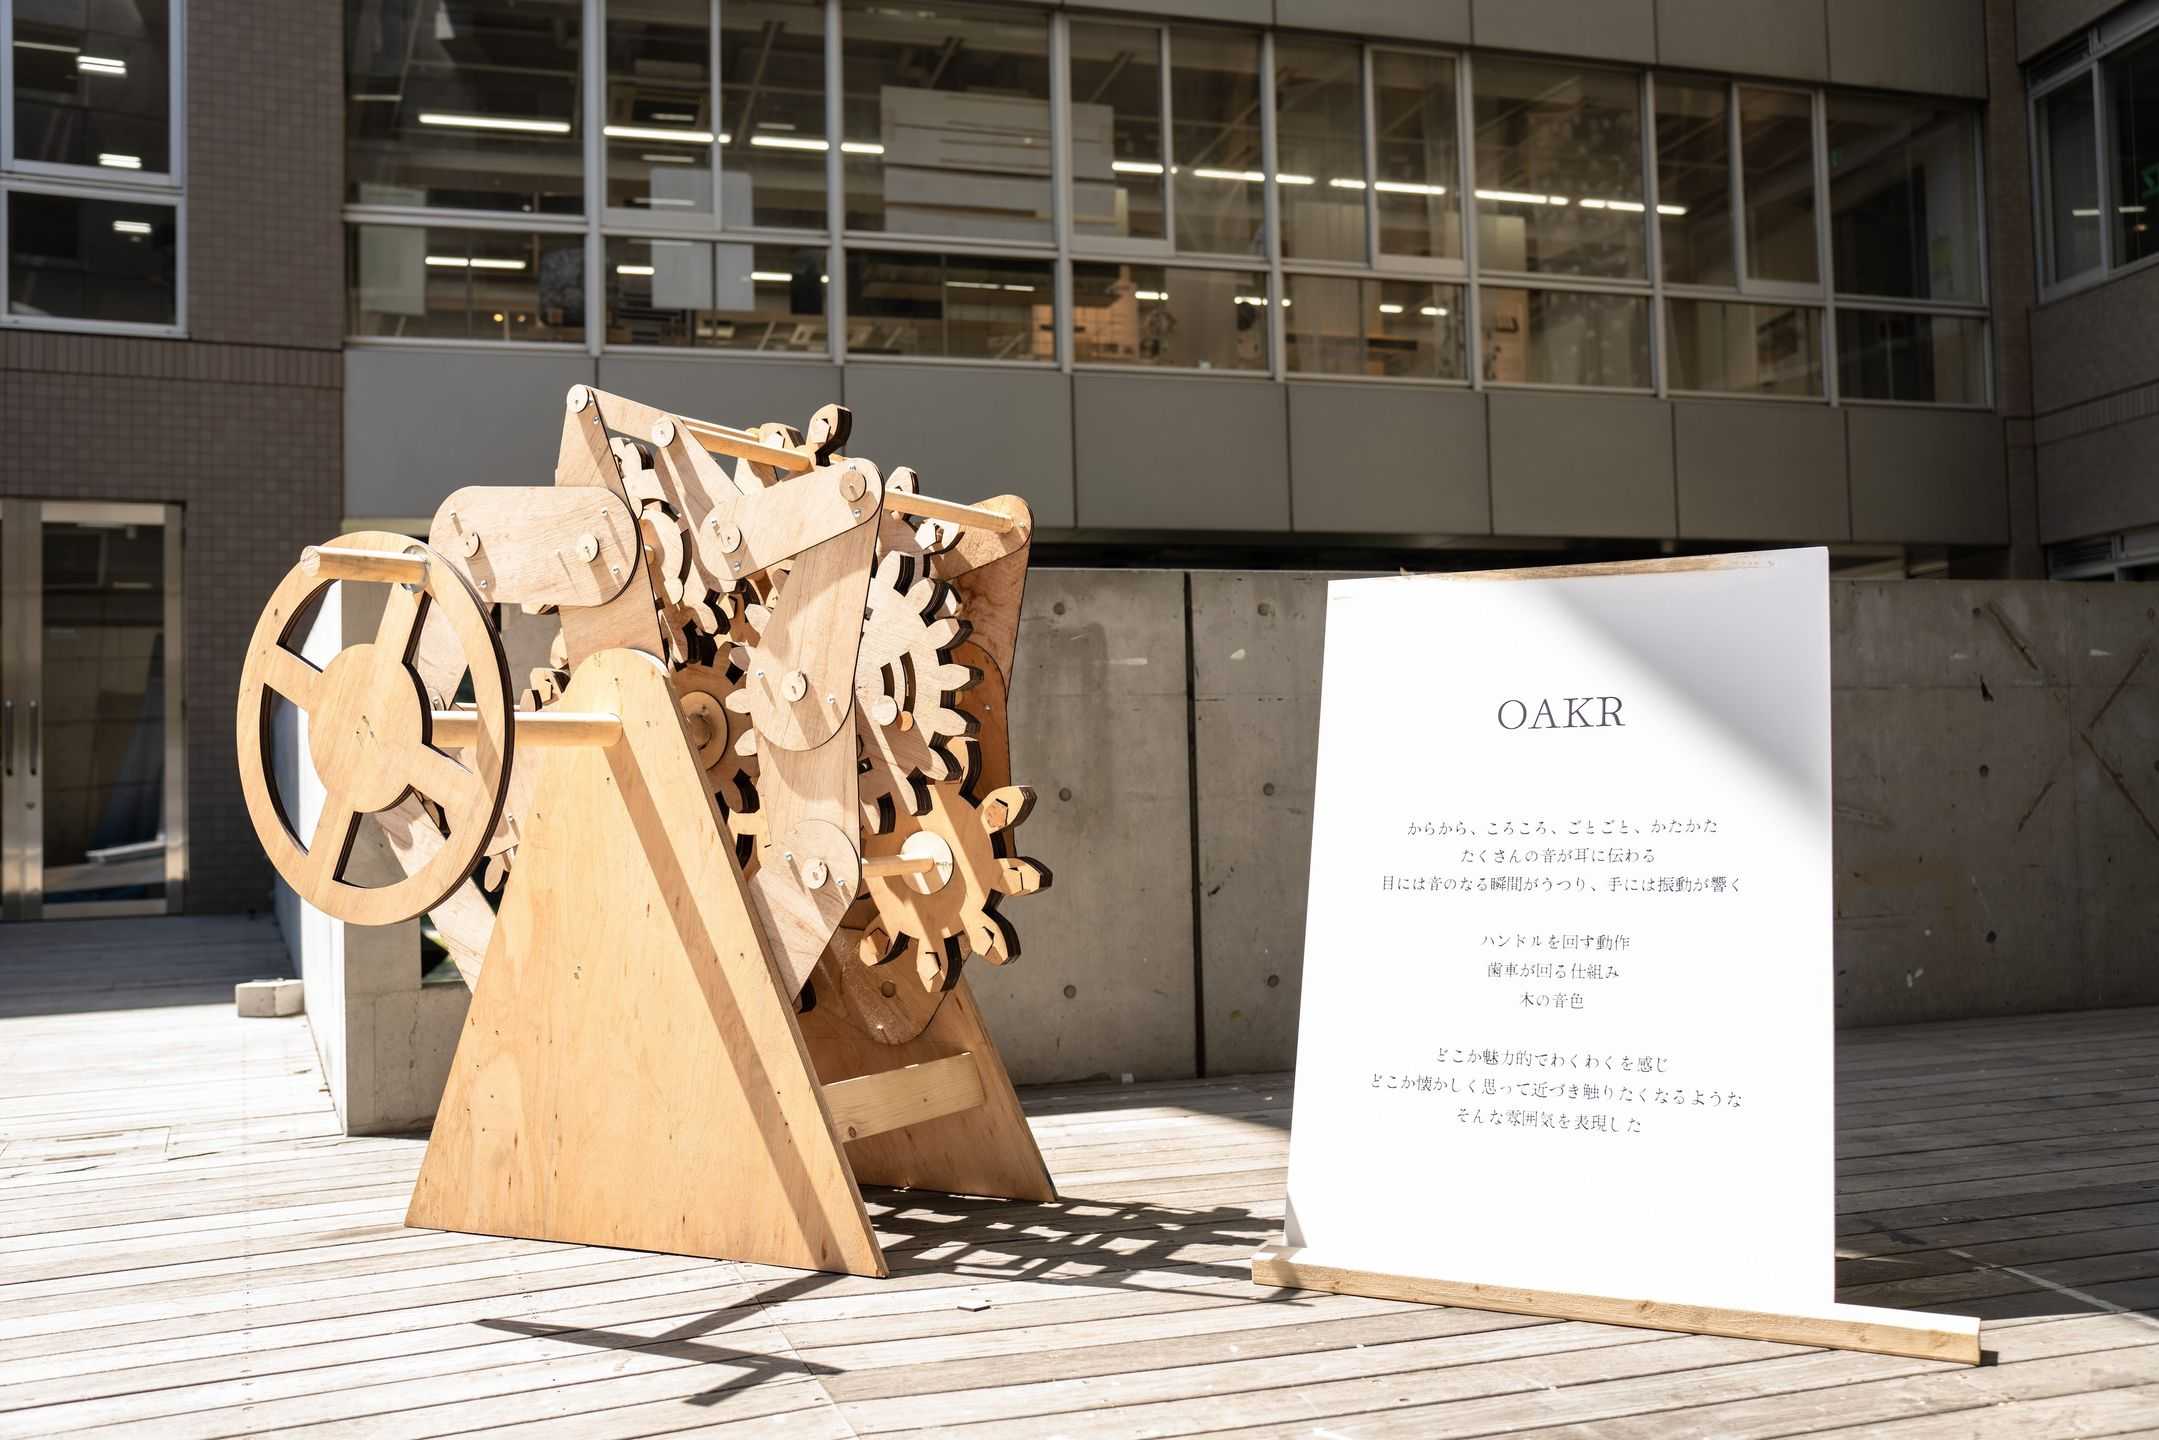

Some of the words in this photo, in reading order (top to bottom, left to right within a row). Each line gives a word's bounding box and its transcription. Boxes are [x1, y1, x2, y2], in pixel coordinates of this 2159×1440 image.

[1497, 696, 1627, 731] OAKR
[1460, 847, 1656, 865] たくさんの音が耳に伝わる
[1382, 873, 1742, 894] 目には音のなる瞬間がうつり、手には振動が響く
[1481, 933, 1631, 952] ハンドルを回す動作
[1487, 961, 1620, 980] 歯車が回る仕組み
[1519, 991, 1585, 1010] 木の音色
[1436, 1047, 1669, 1073] どこか魅力的でわくわくを感じ
[1370, 1072, 1744, 1108] どこか懐かしく思って近づき触りたくなるような
[1456, 1107, 1642, 1134] そんな雰囲気を表現した
